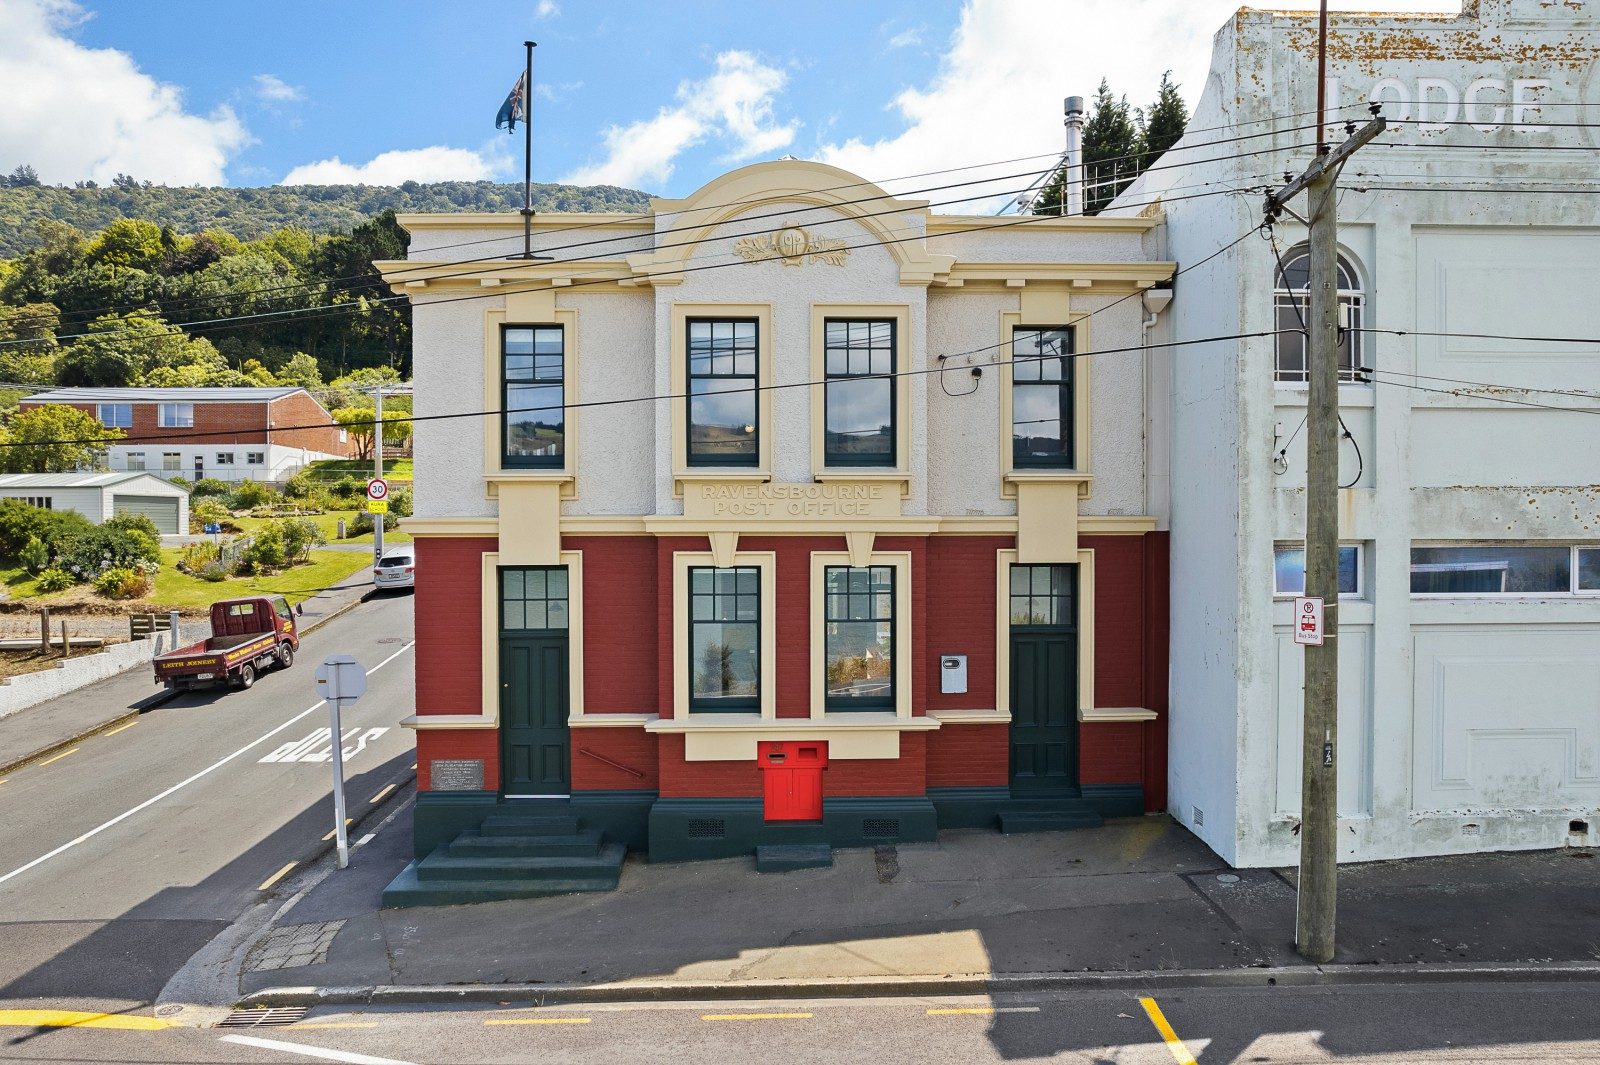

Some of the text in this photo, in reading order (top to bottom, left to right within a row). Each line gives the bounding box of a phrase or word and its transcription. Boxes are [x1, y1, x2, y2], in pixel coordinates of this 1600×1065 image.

[1326, 77, 1551, 132] LODGE
[372, 485, 384, 494] 30
[701, 484, 884, 500] RAVENSBOURNE
[714, 501, 870, 516] POST OFFICE
[186, 659, 217, 667] JOINERY
